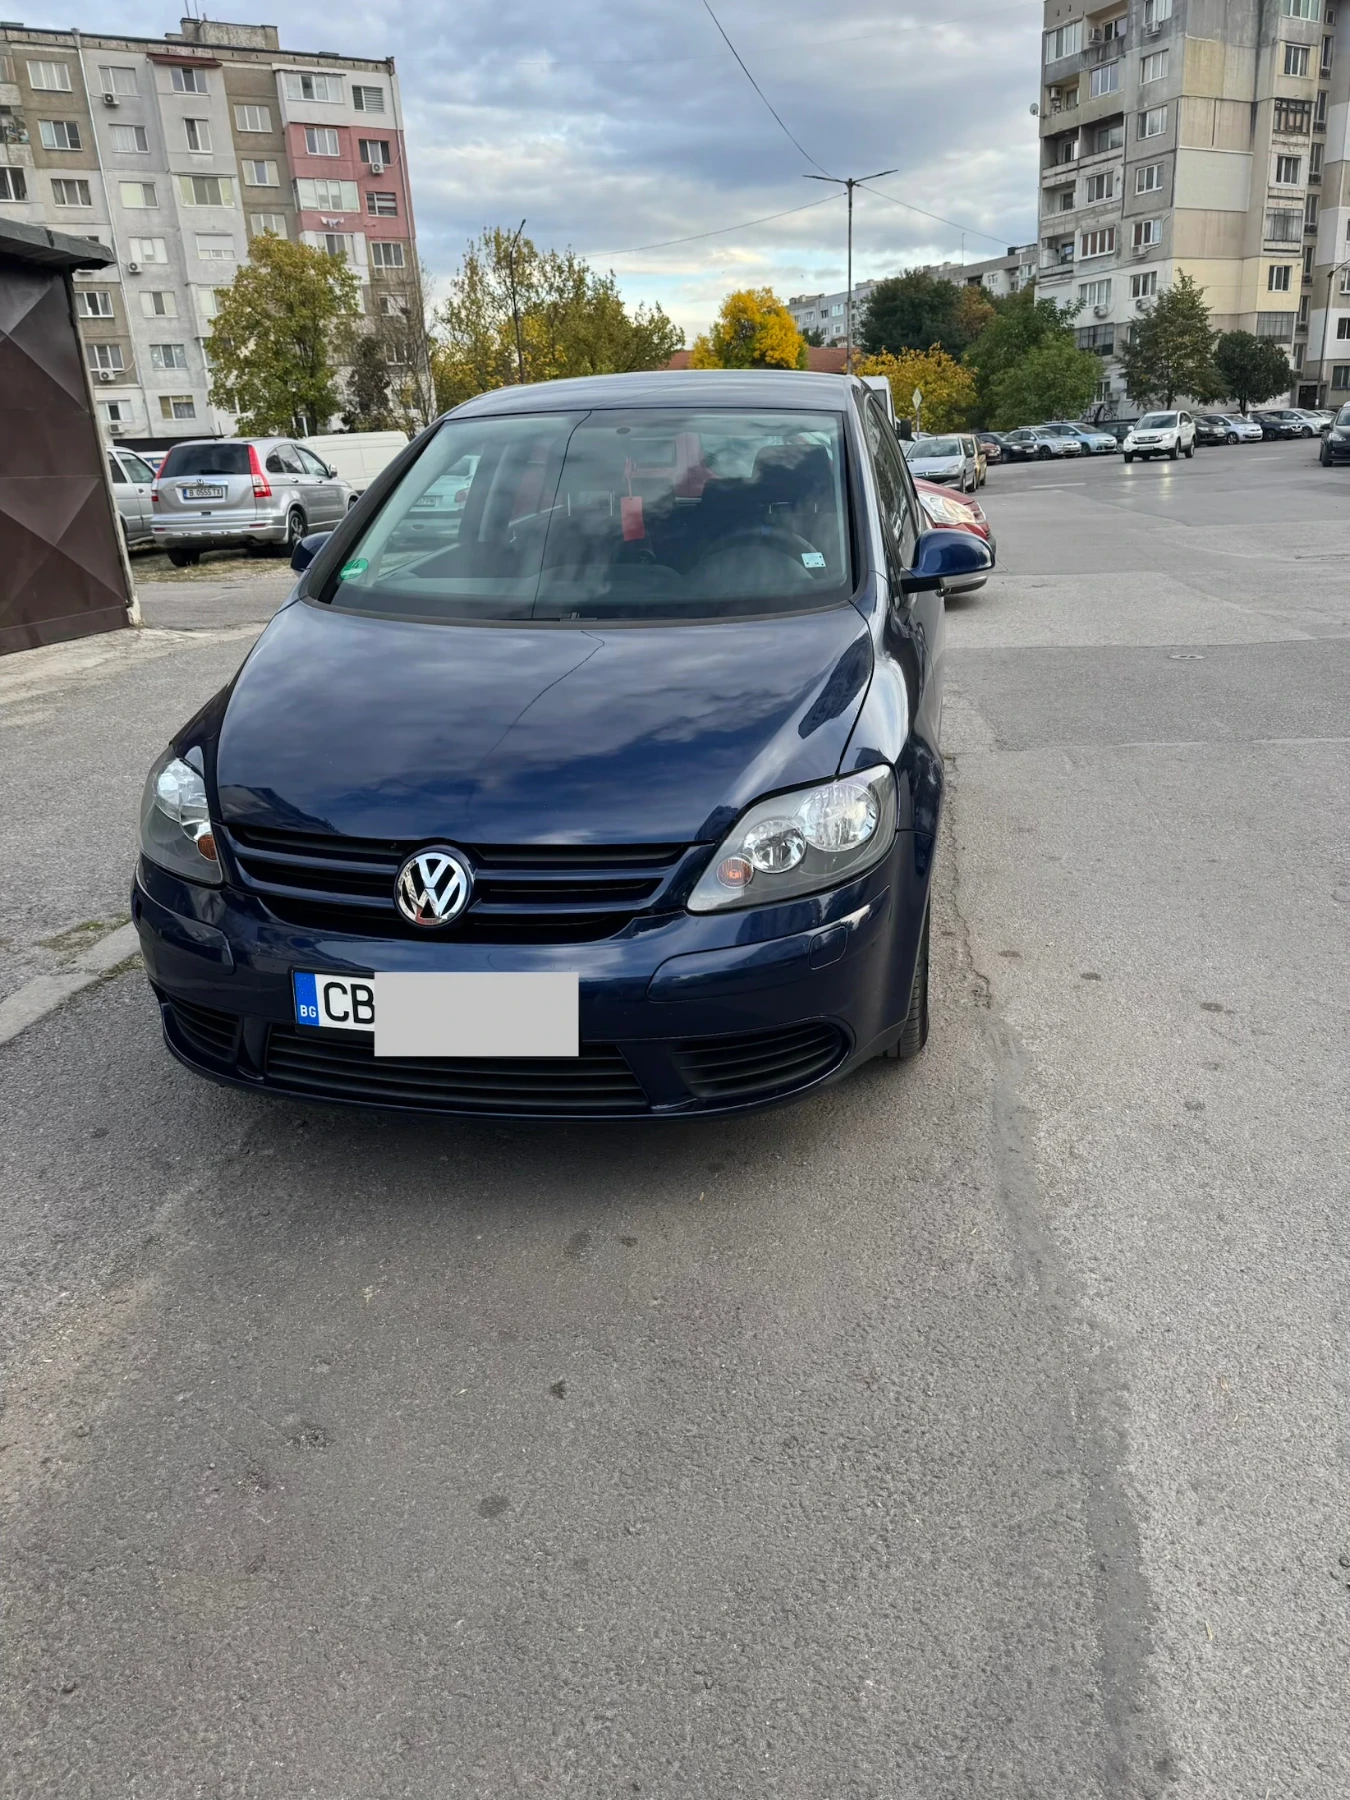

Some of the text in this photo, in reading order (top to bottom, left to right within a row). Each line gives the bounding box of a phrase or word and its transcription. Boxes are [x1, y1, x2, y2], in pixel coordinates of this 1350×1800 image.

[350, 559, 359, 568] 4
[398, 852, 467, 925] VW
[299, 1004, 317, 1018] BG
[323, 981, 375, 1025] CB
